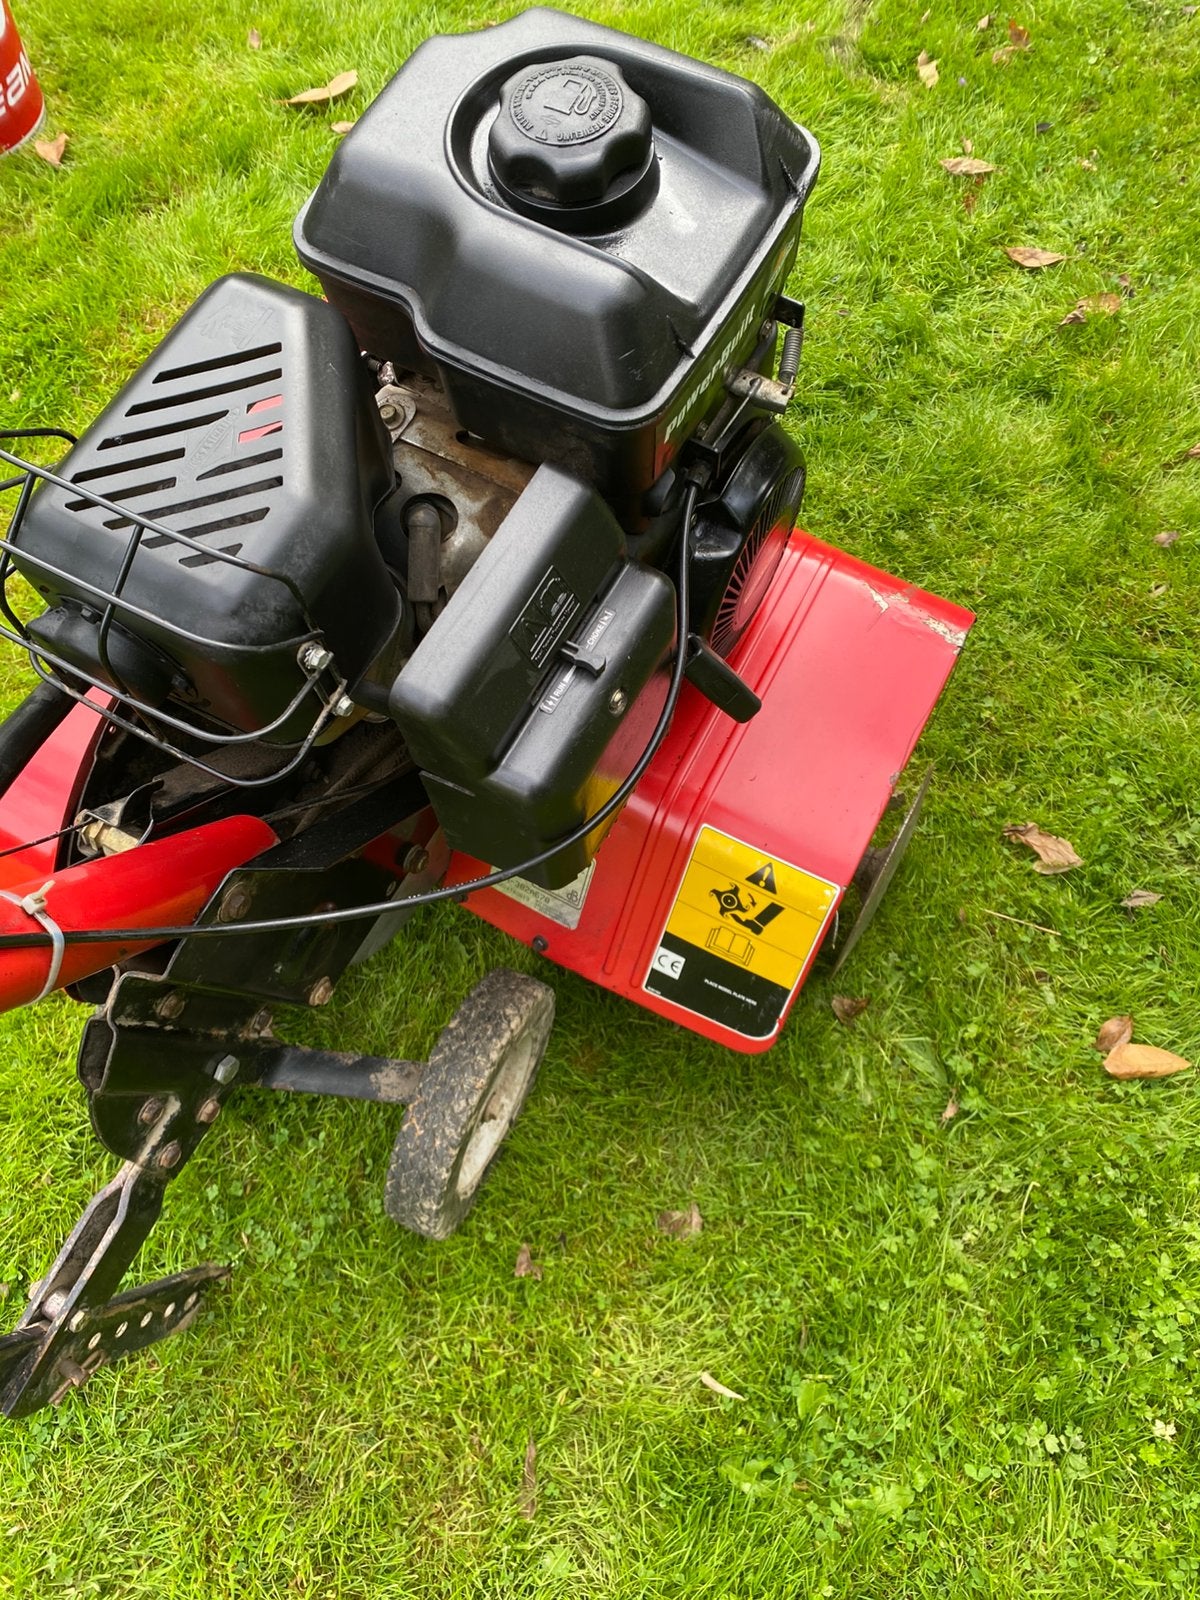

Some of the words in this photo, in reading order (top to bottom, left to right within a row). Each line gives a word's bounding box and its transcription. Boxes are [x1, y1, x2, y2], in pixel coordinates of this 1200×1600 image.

[587, 623, 604, 646] CHOKE
[553, 682, 567, 697] RUN
[658, 954, 682, 974] CE
